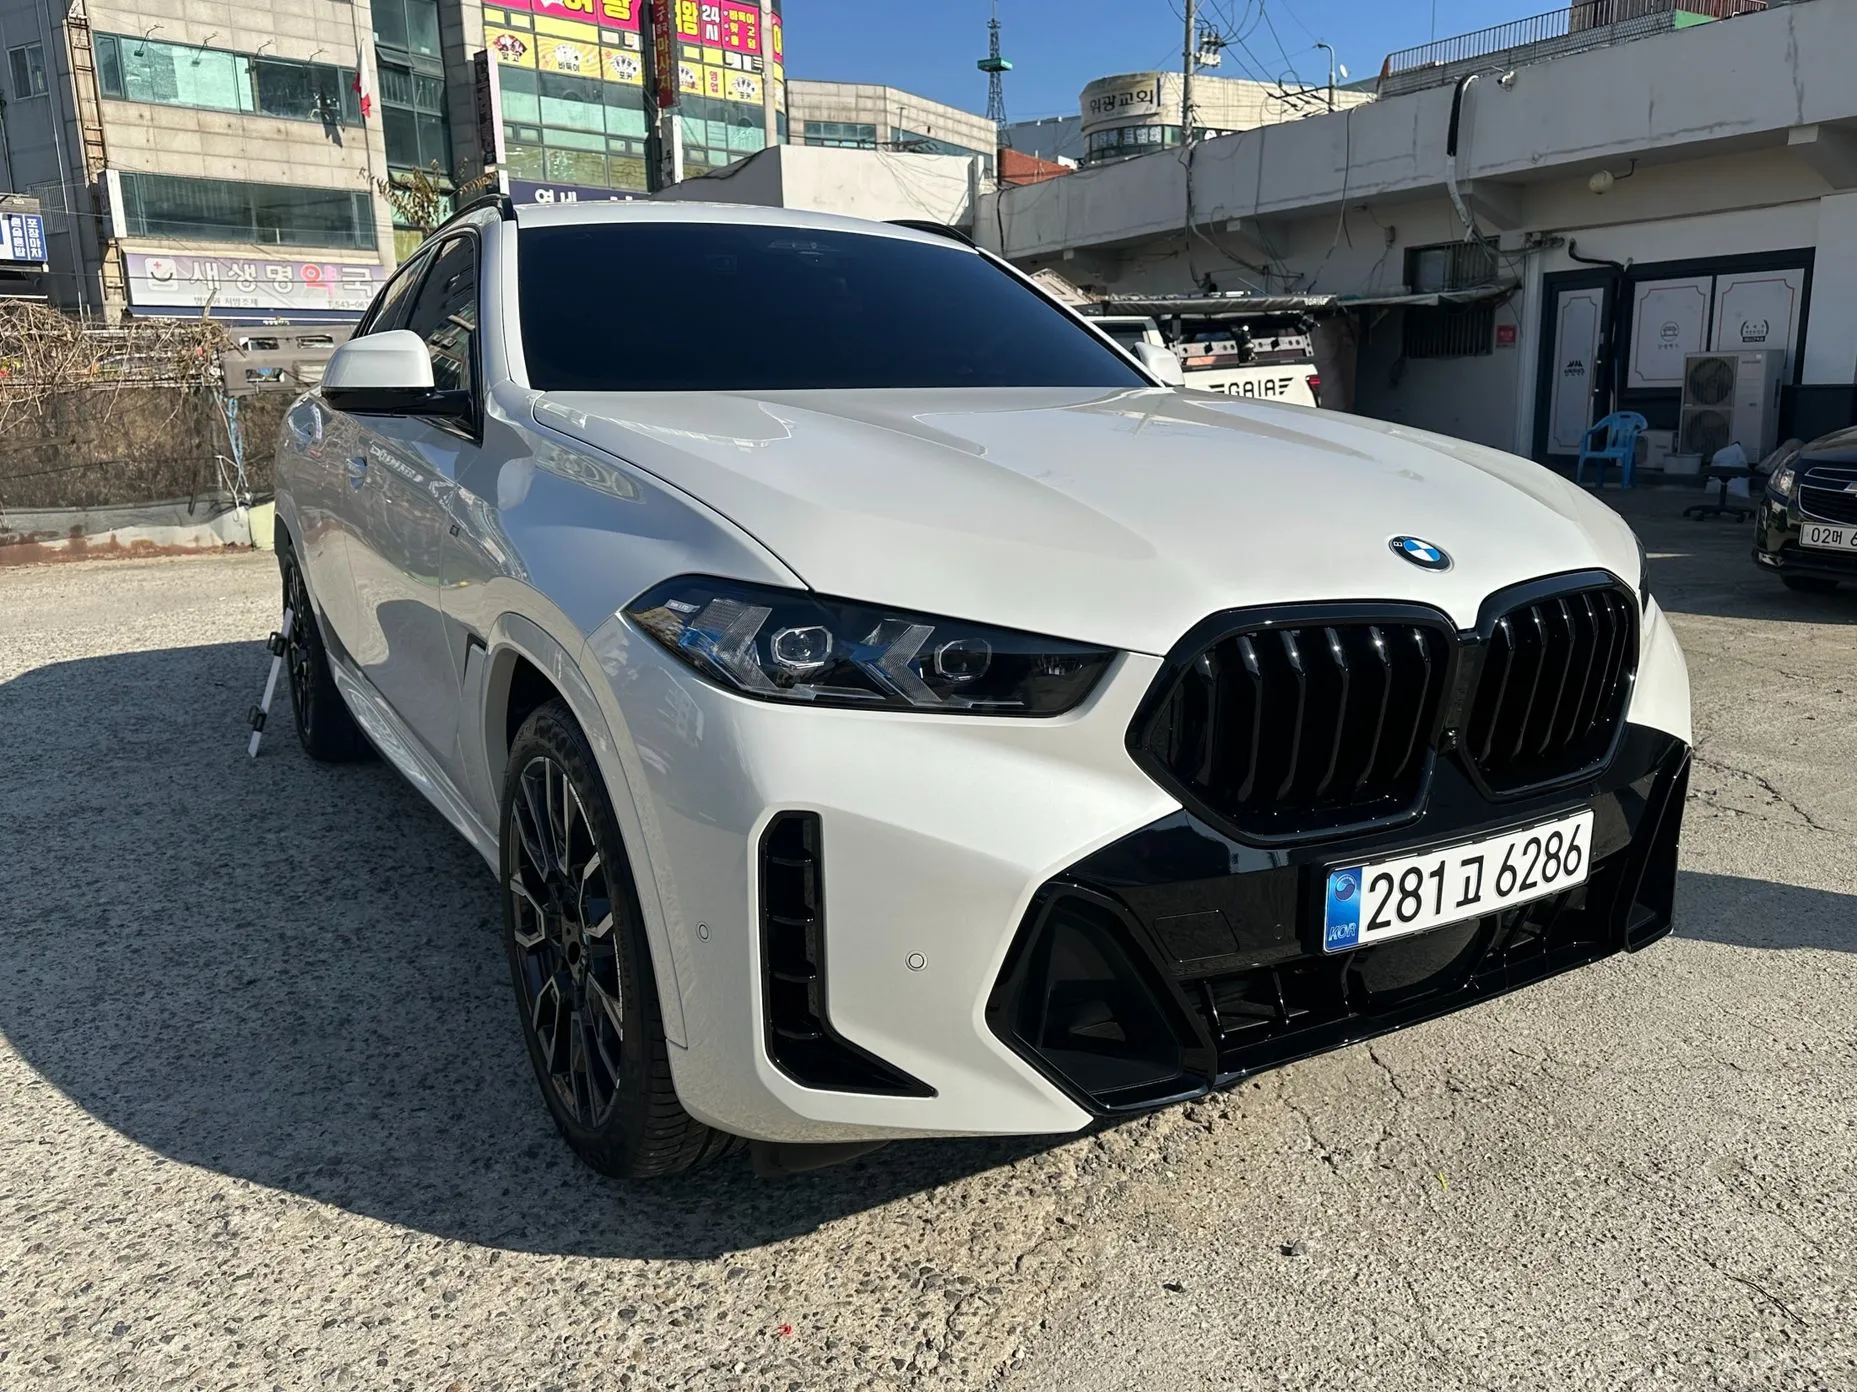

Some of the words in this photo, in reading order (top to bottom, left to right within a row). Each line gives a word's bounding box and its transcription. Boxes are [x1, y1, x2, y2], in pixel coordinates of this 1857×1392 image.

[702, 4, 720, 23] 24
[729, 10, 755, 24] 바둑이
[558, 62, 580, 72] 바둑이
[617, 70, 633, 80] 포커
[1089, 89, 1154, 115] 위광교회
[188, 261, 376, 299] 새생명약국
[1228, 379, 1276, 398] GAIA
[1811, 527, 1843, 545] 02머
[1495, 823, 1582, 898] 6286
[1328, 922, 1356, 941] KOR
